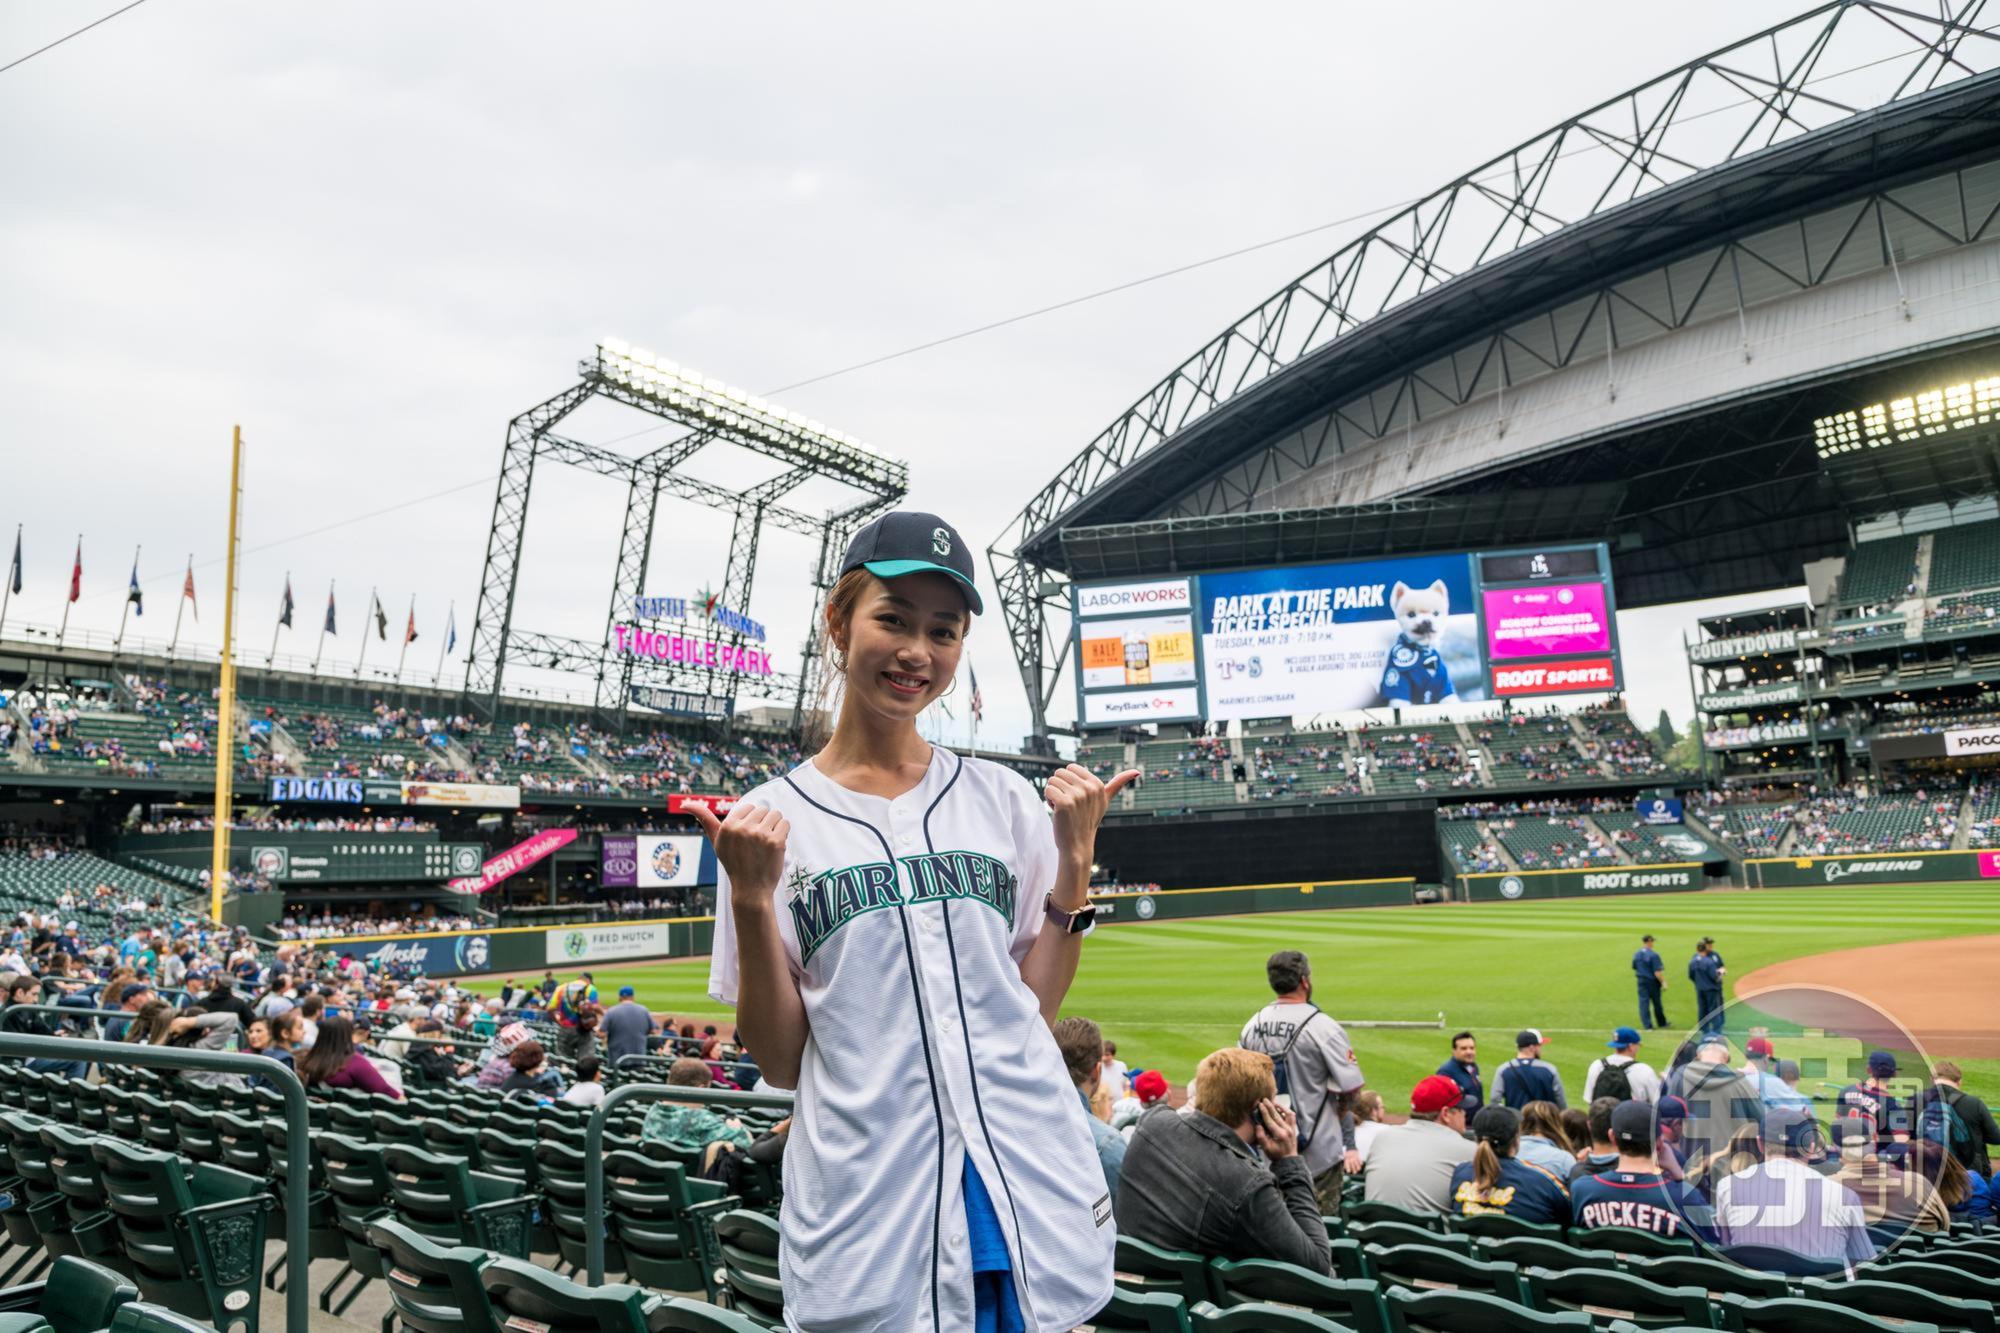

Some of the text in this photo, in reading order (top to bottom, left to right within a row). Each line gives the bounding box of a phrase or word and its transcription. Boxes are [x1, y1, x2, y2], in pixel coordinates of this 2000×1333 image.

[635, 597, 686, 618] SEATTLE
[1081, 588, 1187, 607] LABORWORKS
[1213, 584, 1386, 618] BARK AT THE PARK
[1211, 609, 1335, 634] TICKET SPECIAL
[614, 626, 773, 676] T-MOBILE PARK
[1258, 634, 1277, 647] MAY
[1690, 634, 1796, 660] COUNTDOWN
[1495, 667, 1608, 688] ROOT SPORTS
[1701, 686, 1799, 710] COOPERSTOWN
[1774, 723, 1808, 738] DAYS
[272, 779, 363, 803] EDGARS
[482, 854, 516, 882] PEN
[1848, 860, 1924, 873] BOEING
[1583, 873, 1690, 889] ROOT SPORTS
[593, 931, 655, 943] FRED HUTCH
[1253, 1021, 1296, 1039] MAUER
[1583, 1201, 1681, 1236] PUCKETT
